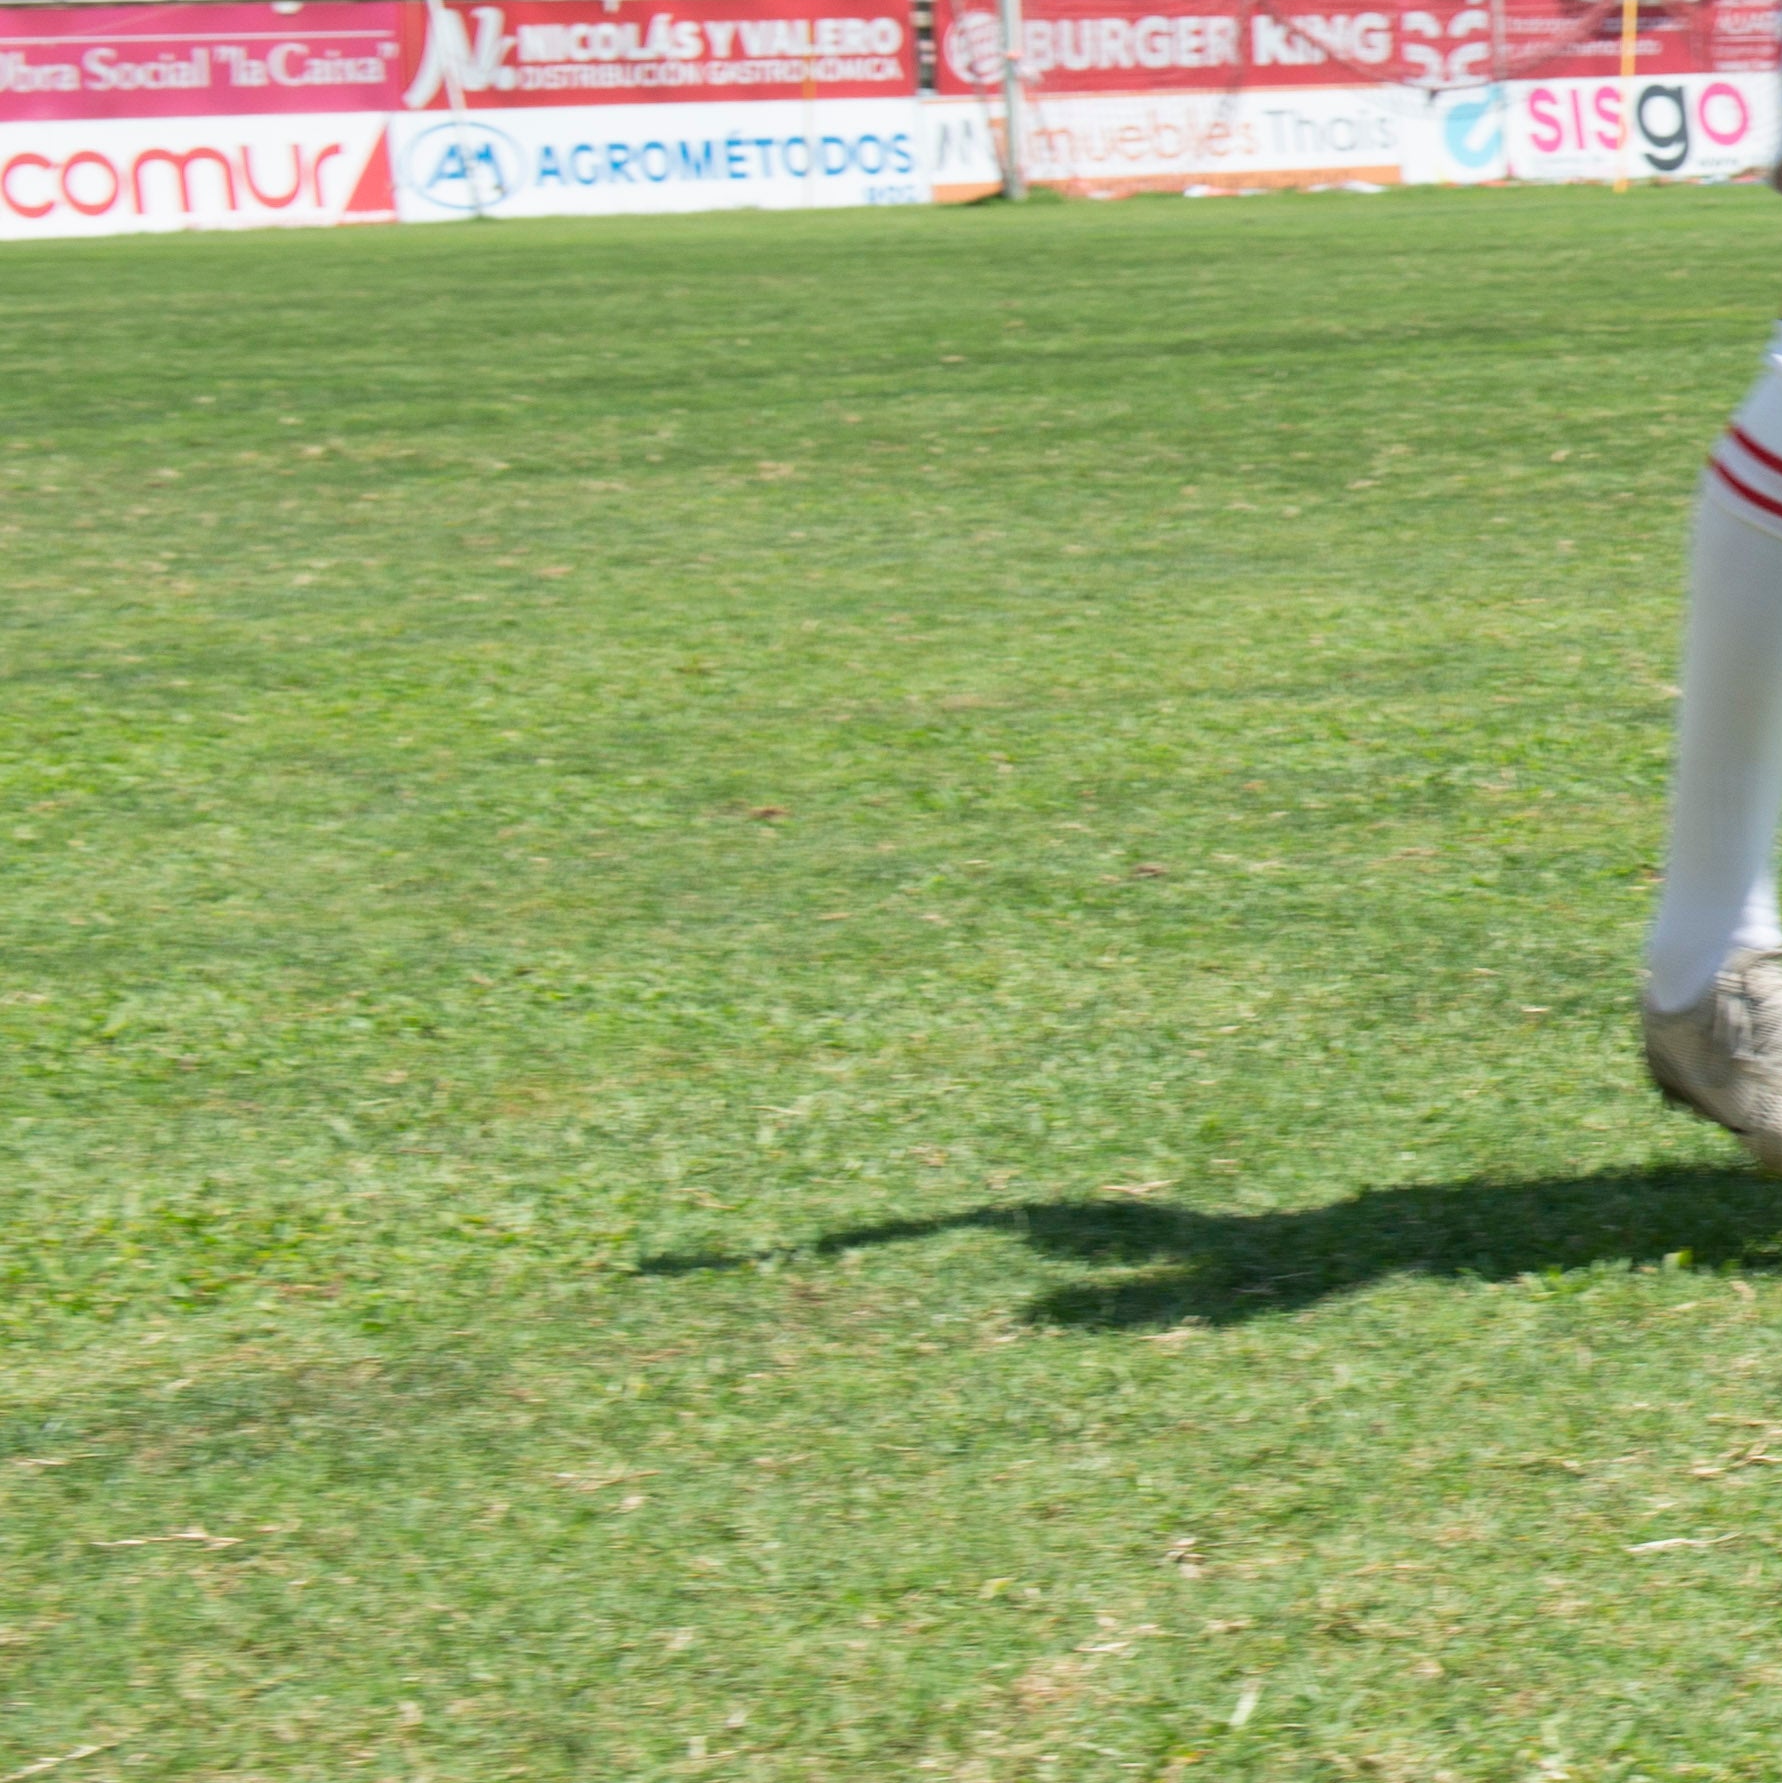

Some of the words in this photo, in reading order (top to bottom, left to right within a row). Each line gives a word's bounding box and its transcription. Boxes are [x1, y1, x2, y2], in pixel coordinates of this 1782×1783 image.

[517, 13, 702, 63] NICOLÁS
[735, 18, 904, 57] VALERO
[1023, 15, 1237, 72] BURGER
[1250, 12, 1393, 66] KING
[83, 47, 211, 91] Social
[2, 143, 345, 218] comur
[535, 129, 917, 187] AGROMÉTODOS
